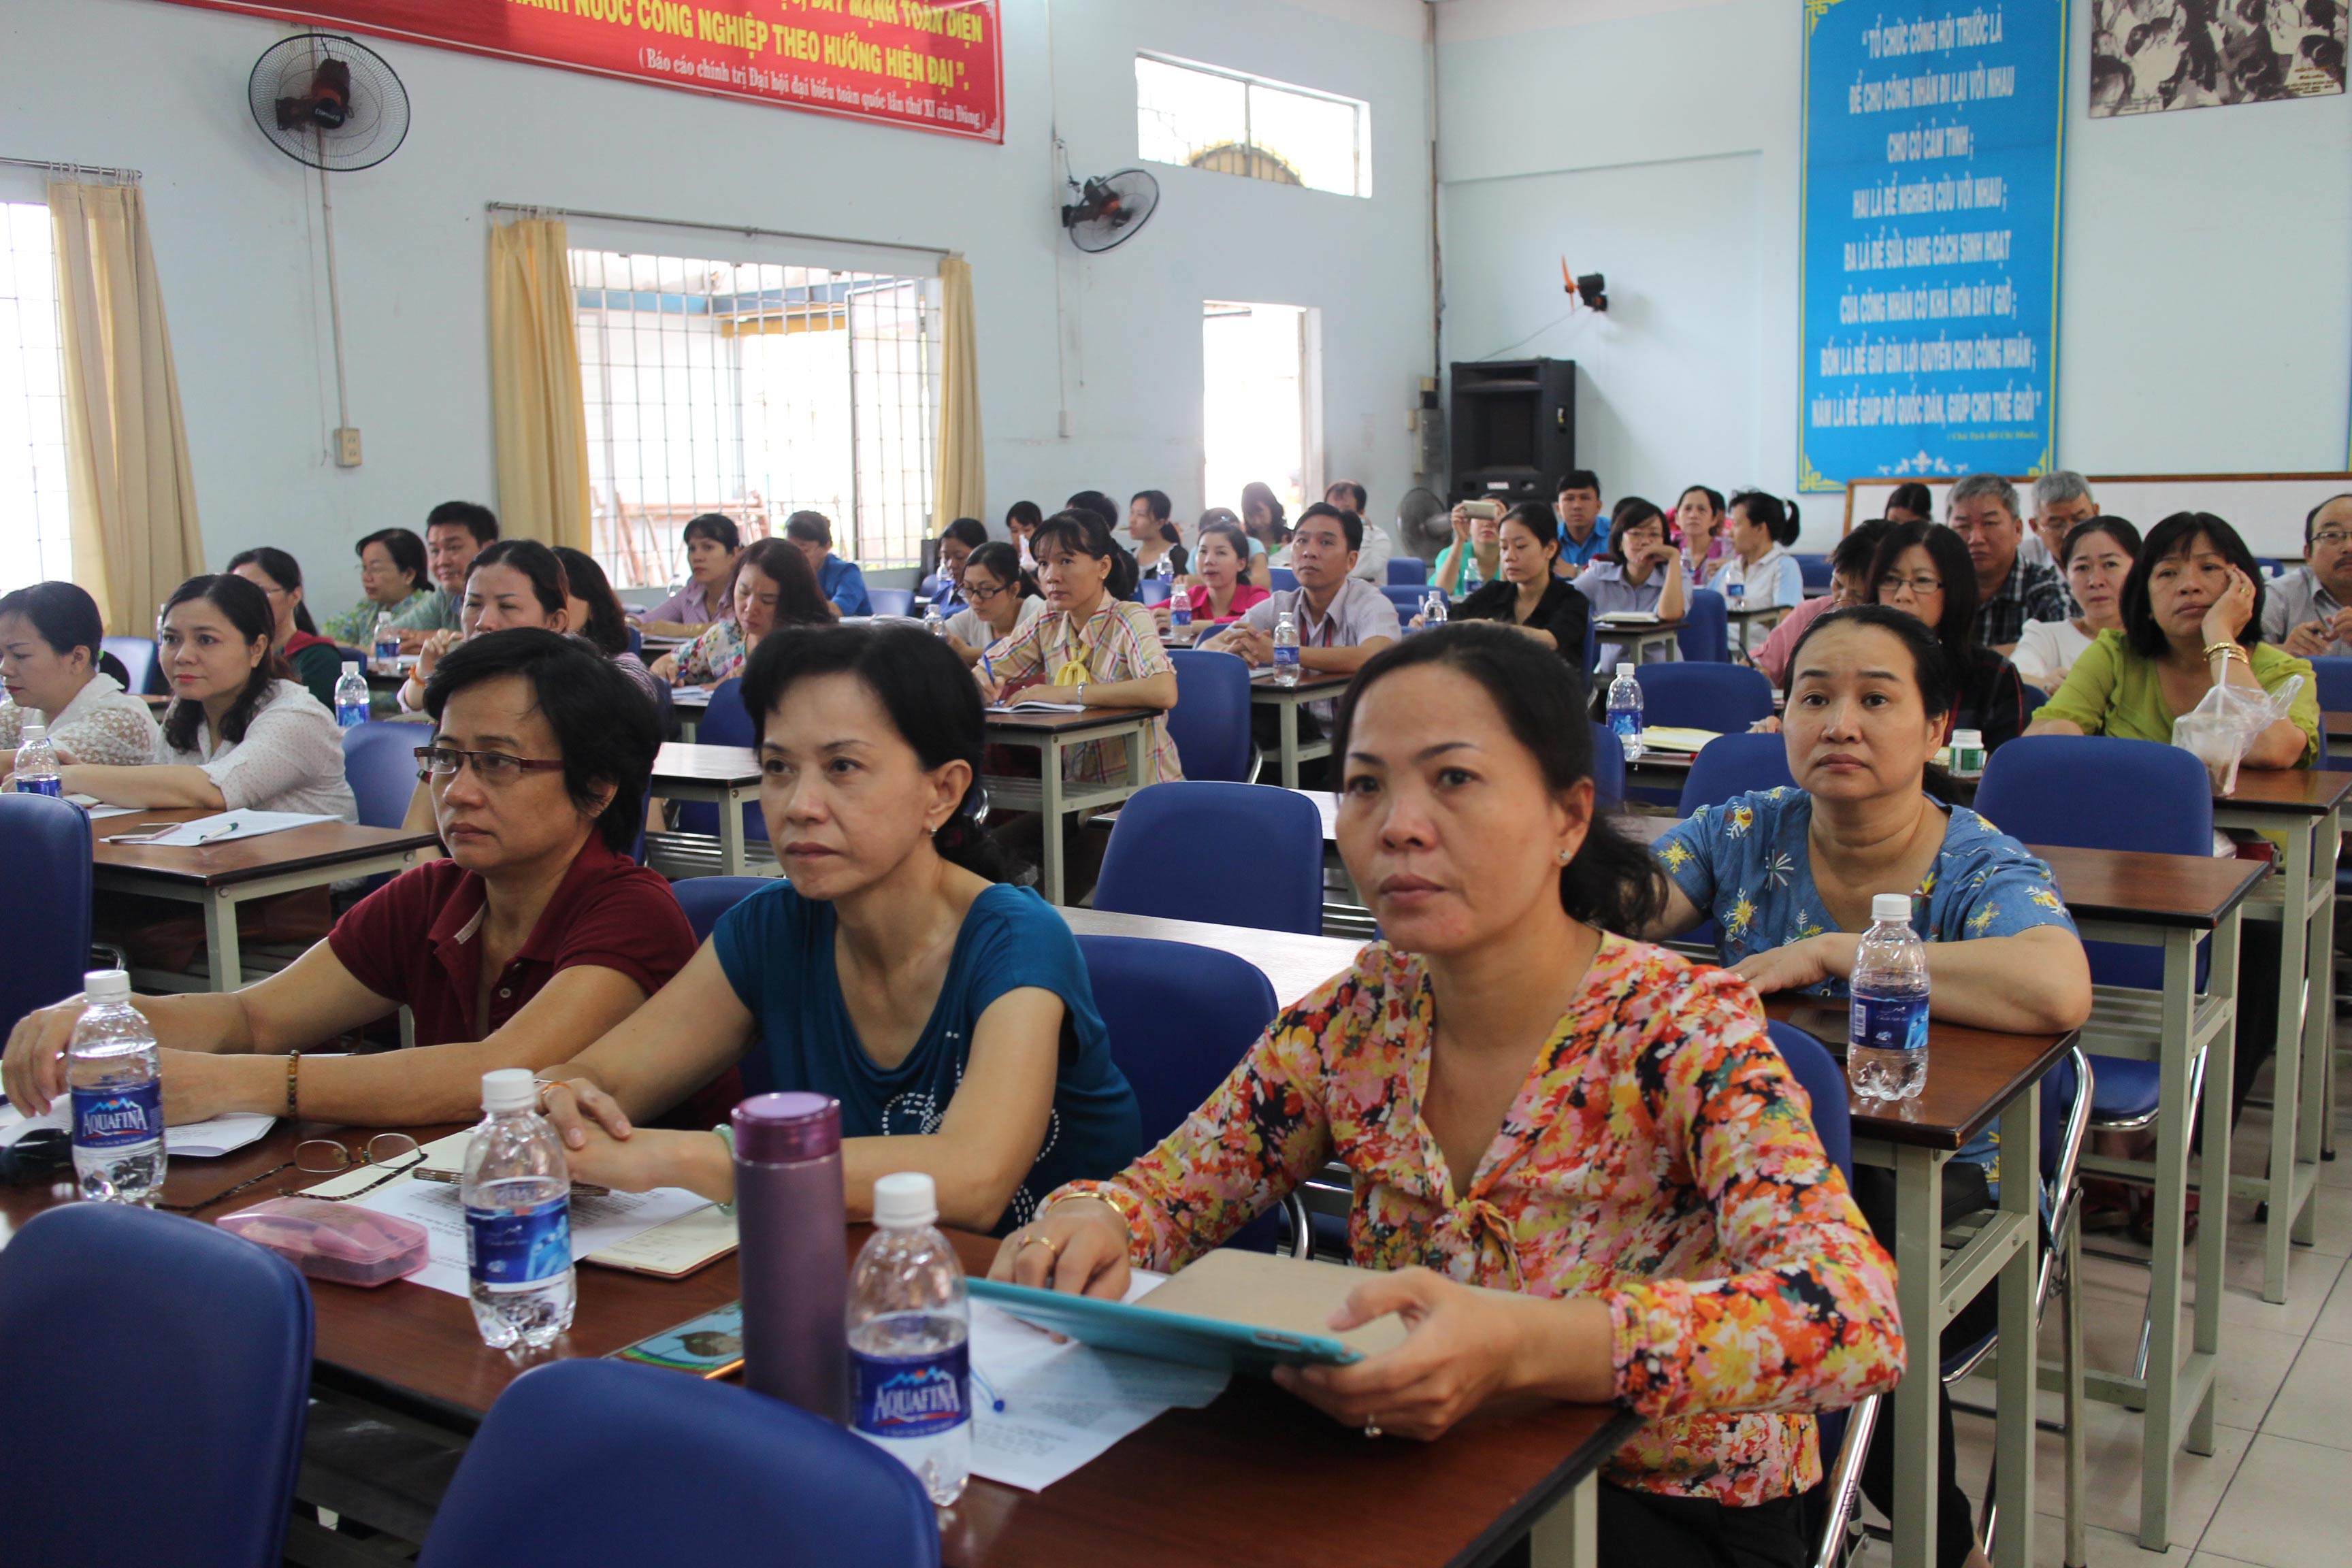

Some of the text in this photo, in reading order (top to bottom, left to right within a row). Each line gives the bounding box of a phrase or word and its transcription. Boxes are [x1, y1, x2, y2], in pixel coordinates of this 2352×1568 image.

[697, 7, 769, 59] NGHIỆP
[770, 23, 820, 62] THEO
[823, 31, 883, 74] HƯỚNG
[885, 44, 924, 88] HIỆN
[1882, 17, 1908, 57] CHỨC
[1910, 16, 1936, 54] CÔNG
[1937, 12, 1955, 58] HỘI
[1956, 6, 1988, 48] TRƯỚC
[1989, 3, 2002, 44] LÀ
[674, 54, 695, 76] cáo
[697, 58, 730, 82] chính
[732, 65, 747, 90] trị
[749, 67, 770, 93] Đại
[770, 70, 789, 95] hội
[791, 75, 809, 99] đại
[811, 77, 834, 100] biểu
[836, 85, 860, 105] toàn
[861, 88, 886, 111] quốc
[1849, 61, 2015, 114] ĐỂ CHO CÔNG NHÂN ĐI LẠI VỚI NHAU
[1887, 131, 1907, 163] CHO
[1923, 116, 1944, 160] CẢM
[1852, 189, 1869, 219] HAI
[1870, 178, 1883, 218] LÀ
[1884, 171, 1897, 216] ĐỂ
[1898, 176, 1933, 215] NGHIÊN
[1935, 173, 1955, 212] CỨU
[1956, 171, 1973, 210] VỚI
[1844, 242, 1857, 272] BA
[1858, 233, 1870, 271] LÀ
[1871, 225, 1884, 270] ĐỂ
[1906, 235, 1931, 267] SANG
[1932, 226, 1959, 265] CÁCH
[1959, 232, 1983, 263] SINH
[1984, 229, 2011, 270] HOẠT
[1840, 284, 1859, 325] CỦA
[1860, 287, 1886, 323] CÔNG
[1886, 284, 1913, 321] NHÂN
[1950, 282, 1972, 317] HƠN
[1972, 279, 1993, 316] BÂY
[1820, 335, 1840, 377] BỐN
[1840, 338, 1853, 376] LÀ
[1854, 331, 1867, 375] ĐỂ
[1886, 336, 1903, 373] GÌN
[1920, 328, 1953, 373] QUYỀN
[1953, 338, 1973, 371] CHO
[1974, 331, 2002, 370] CÔNG
[1812, 392, 1832, 428] NĂM
[1833, 389, 1844, 427] LÀ
[1845, 382, 1859, 426] ĐỂ
[1860, 389, 1881, 426] GIÚP
[1897, 382, 1923, 425] QUỐC
[1947, 384, 1970, 423] GIÚP
[1971, 391, 1992, 422] CHO
[1993, 378, 2012, 422] THẾ
[82, 1105, 148, 1137] AQUAFINA
[873, 1376, 961, 1422] AQUAFINA
